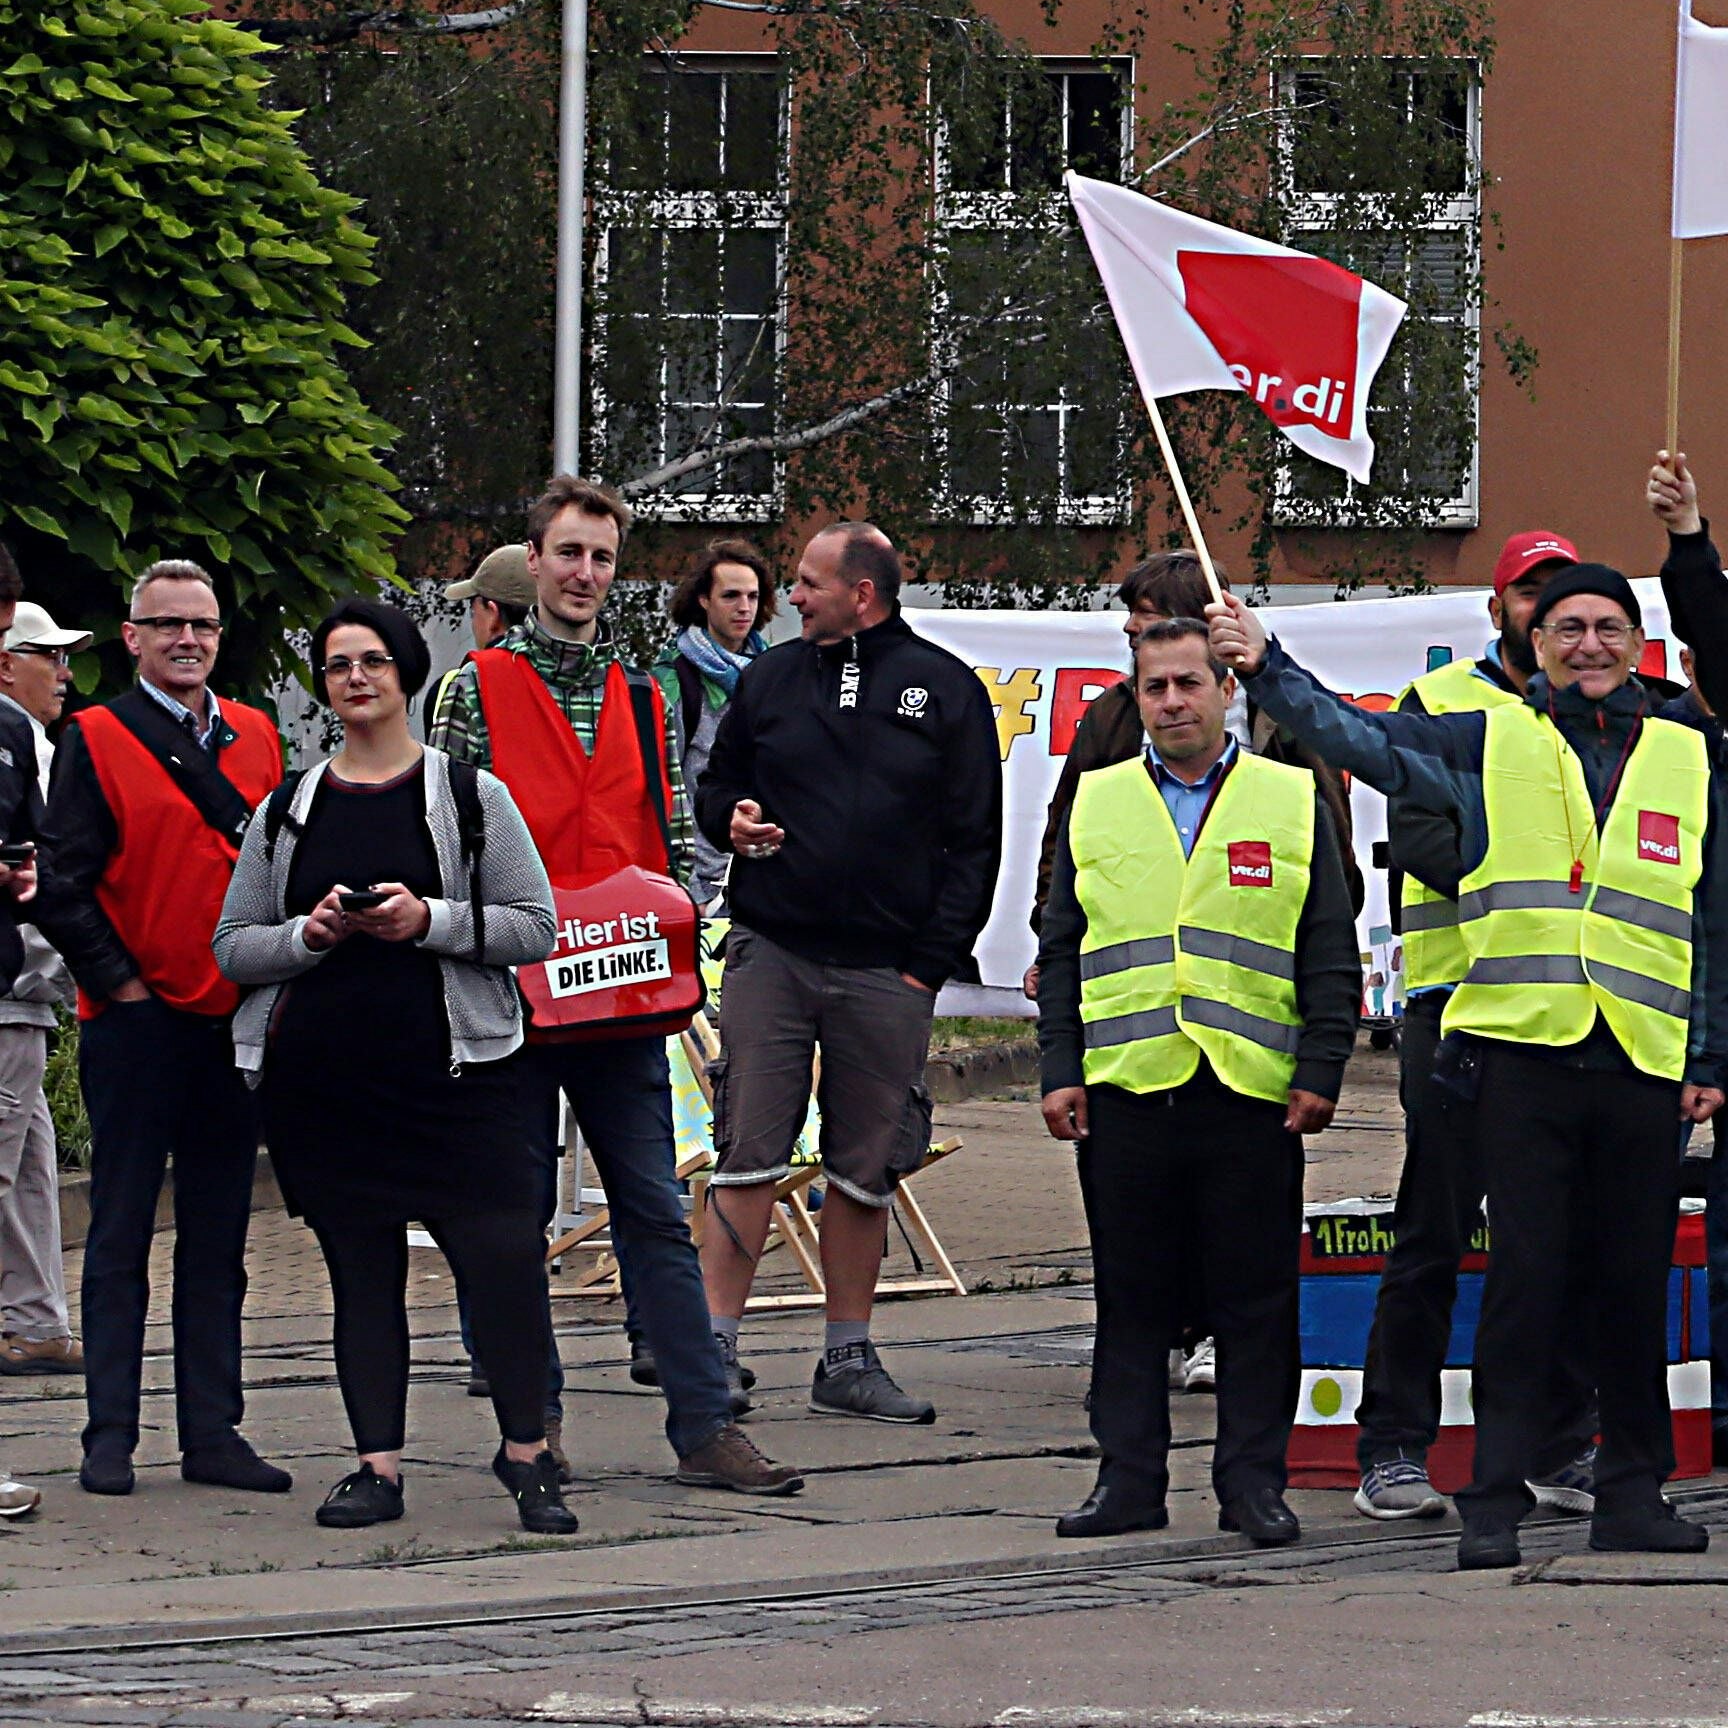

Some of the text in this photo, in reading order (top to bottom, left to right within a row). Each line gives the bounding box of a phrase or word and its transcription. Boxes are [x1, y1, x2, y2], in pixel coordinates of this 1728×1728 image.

[1227, 363, 1347, 424] er.di
[1639, 838, 1678, 860] ver.di
[1230, 865, 1270, 879] ver.di
[552, 911, 660, 952] Hier ist
[558, 960, 594, 990] DIE
